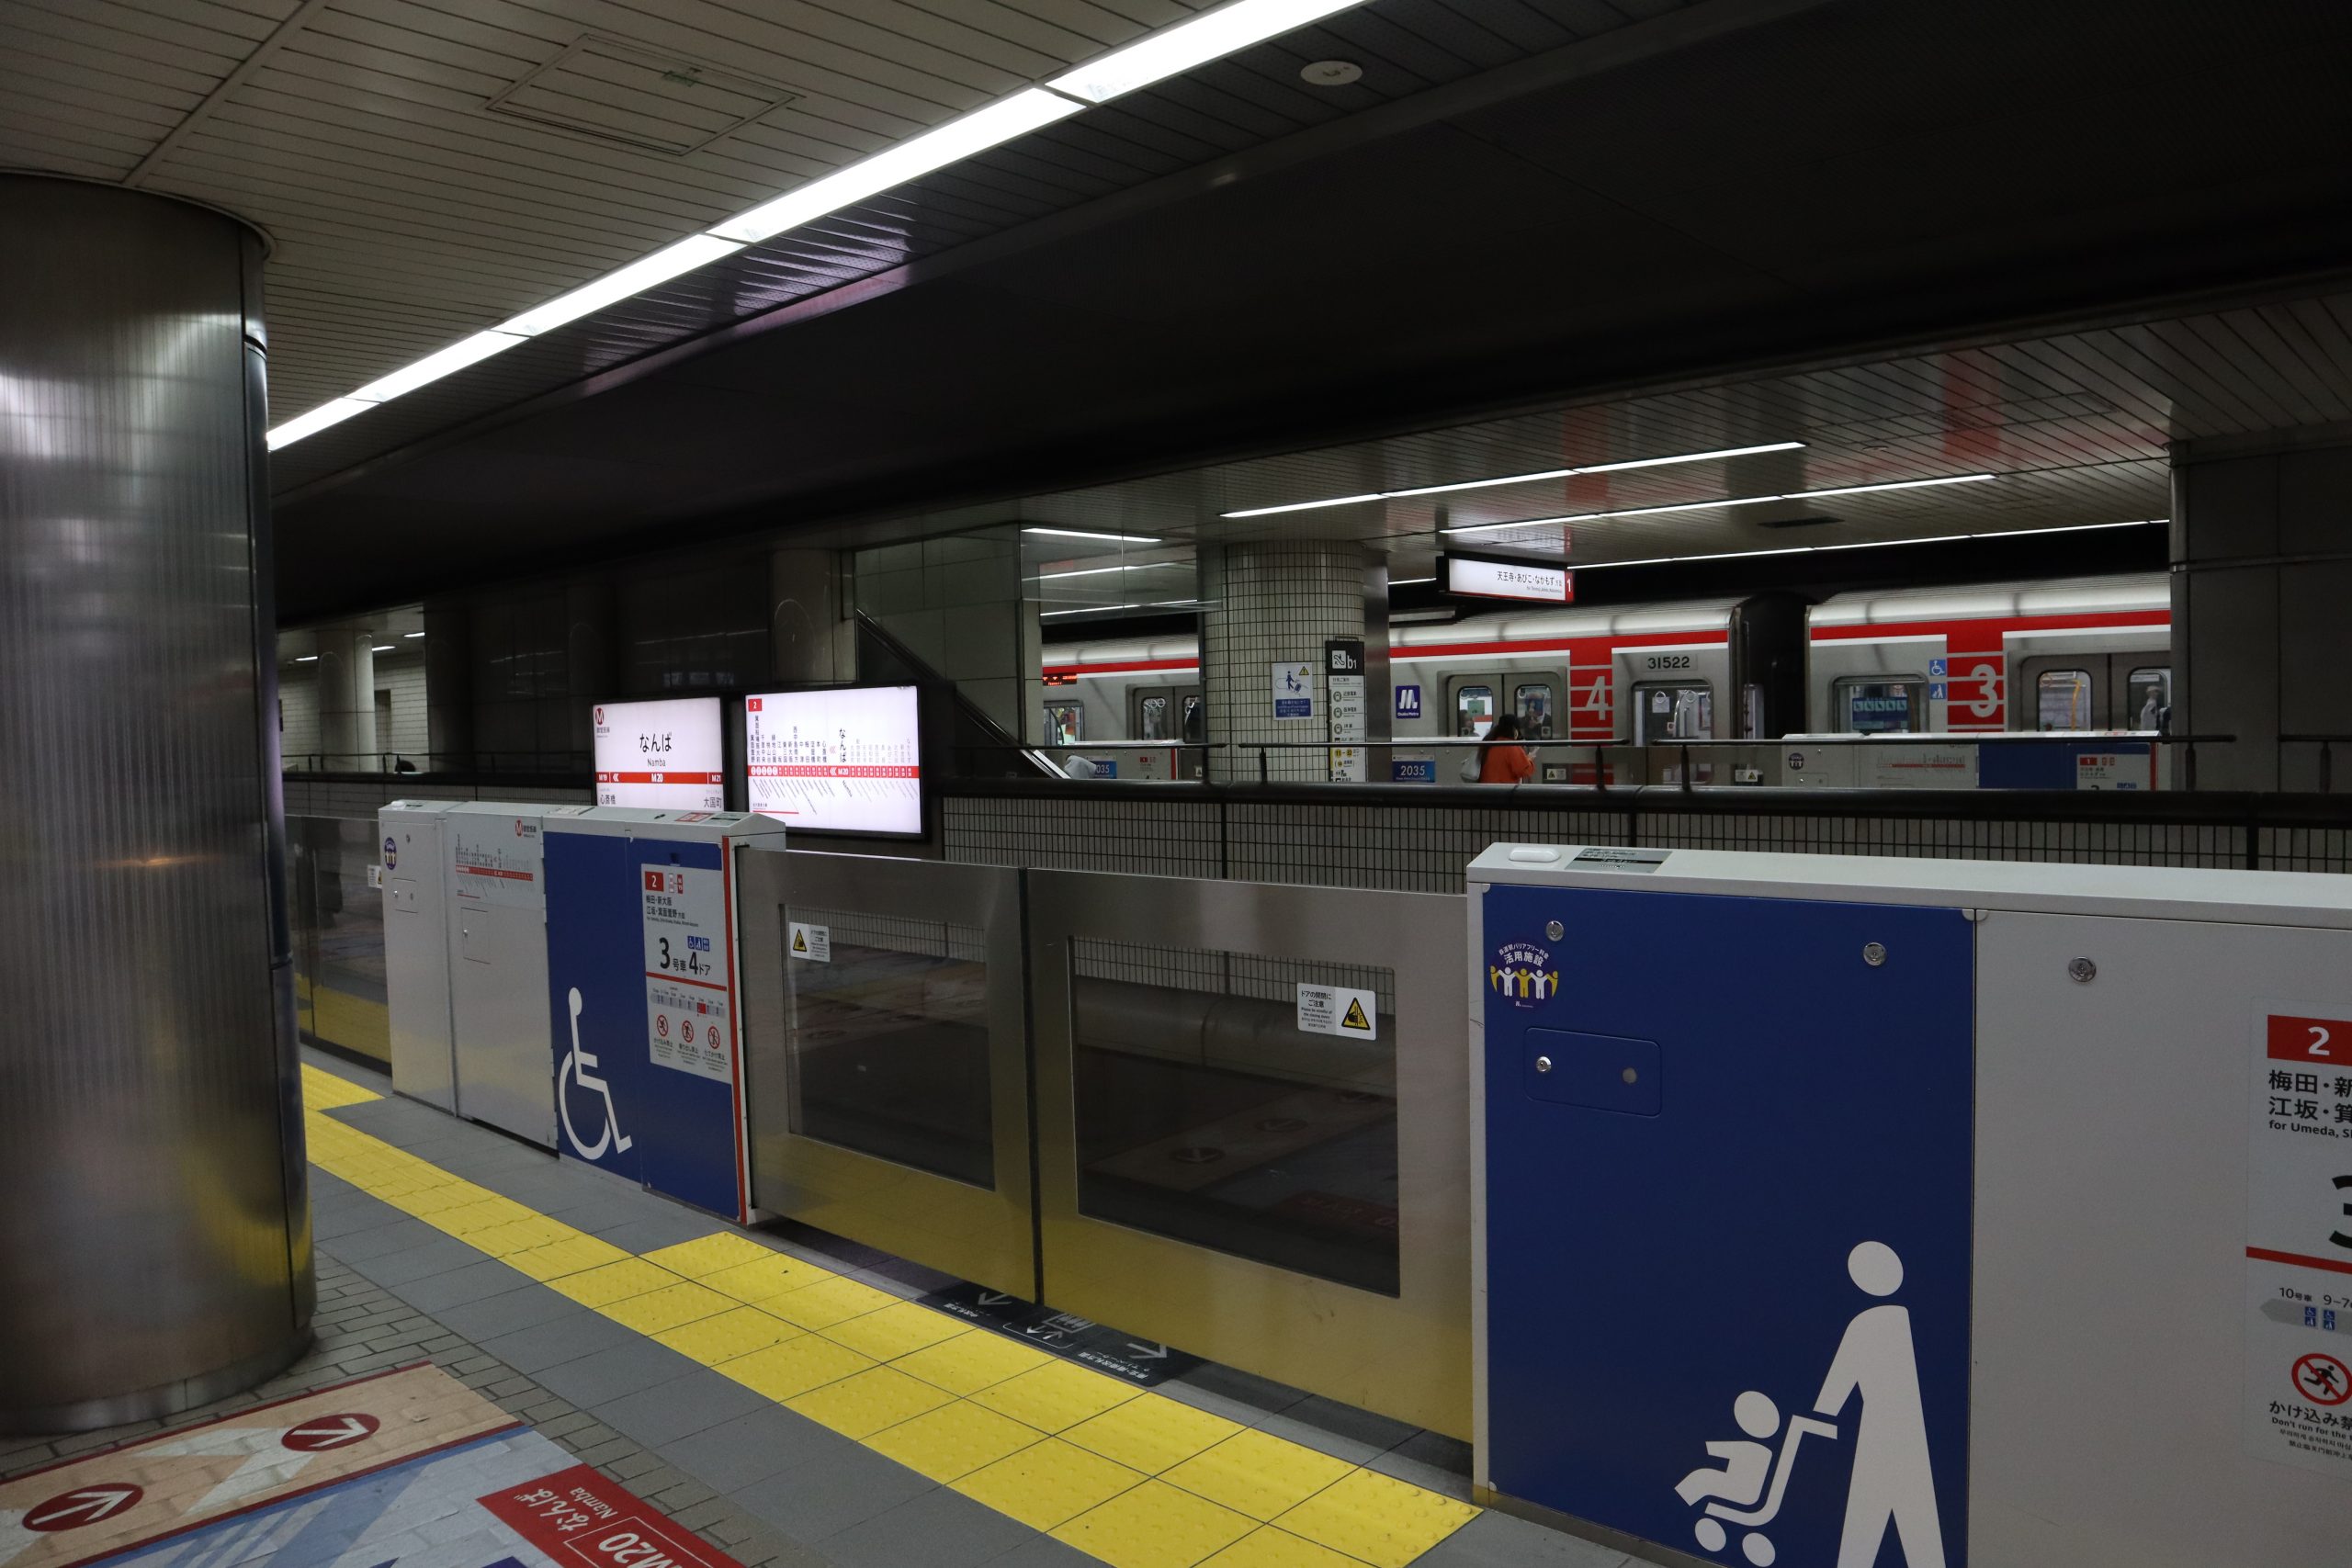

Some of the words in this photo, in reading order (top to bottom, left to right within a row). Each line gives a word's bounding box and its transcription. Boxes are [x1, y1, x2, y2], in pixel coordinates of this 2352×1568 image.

[1566, 579, 1571, 592] 1
[1347, 655, 1357, 670] b1
[1647, 656, 1690, 670] 31522
[1586, 676, 1608, 720] 4
[1970, 663, 1998, 718] 3
[639, 732, 672, 752] なんば
[647, 758, 666, 767] Namba
[650, 773, 663, 783] M20
[1401, 765, 1425, 776] 2035
[704, 796, 722, 808] 大国町
[651, 874, 657, 887] 2
[1504, 951, 1544, 966] 活用施設
[1301, 990, 1331, 999] ドアの開閉に
[2308, 1026, 2330, 1055] 2
[2269, 1120, 2287, 1131] for
[2290, 1122, 2339, 1138] Umeda,
[2272, 1416, 2295, 1428] Don't
[2298, 1424, 2313, 1432] run
[2316, 1427, 2328, 1435] for
[2332, 1431, 2346, 1439] the
[514, 1488, 589, 1531] なんば
[569, 1486, 617, 1519] Namba
